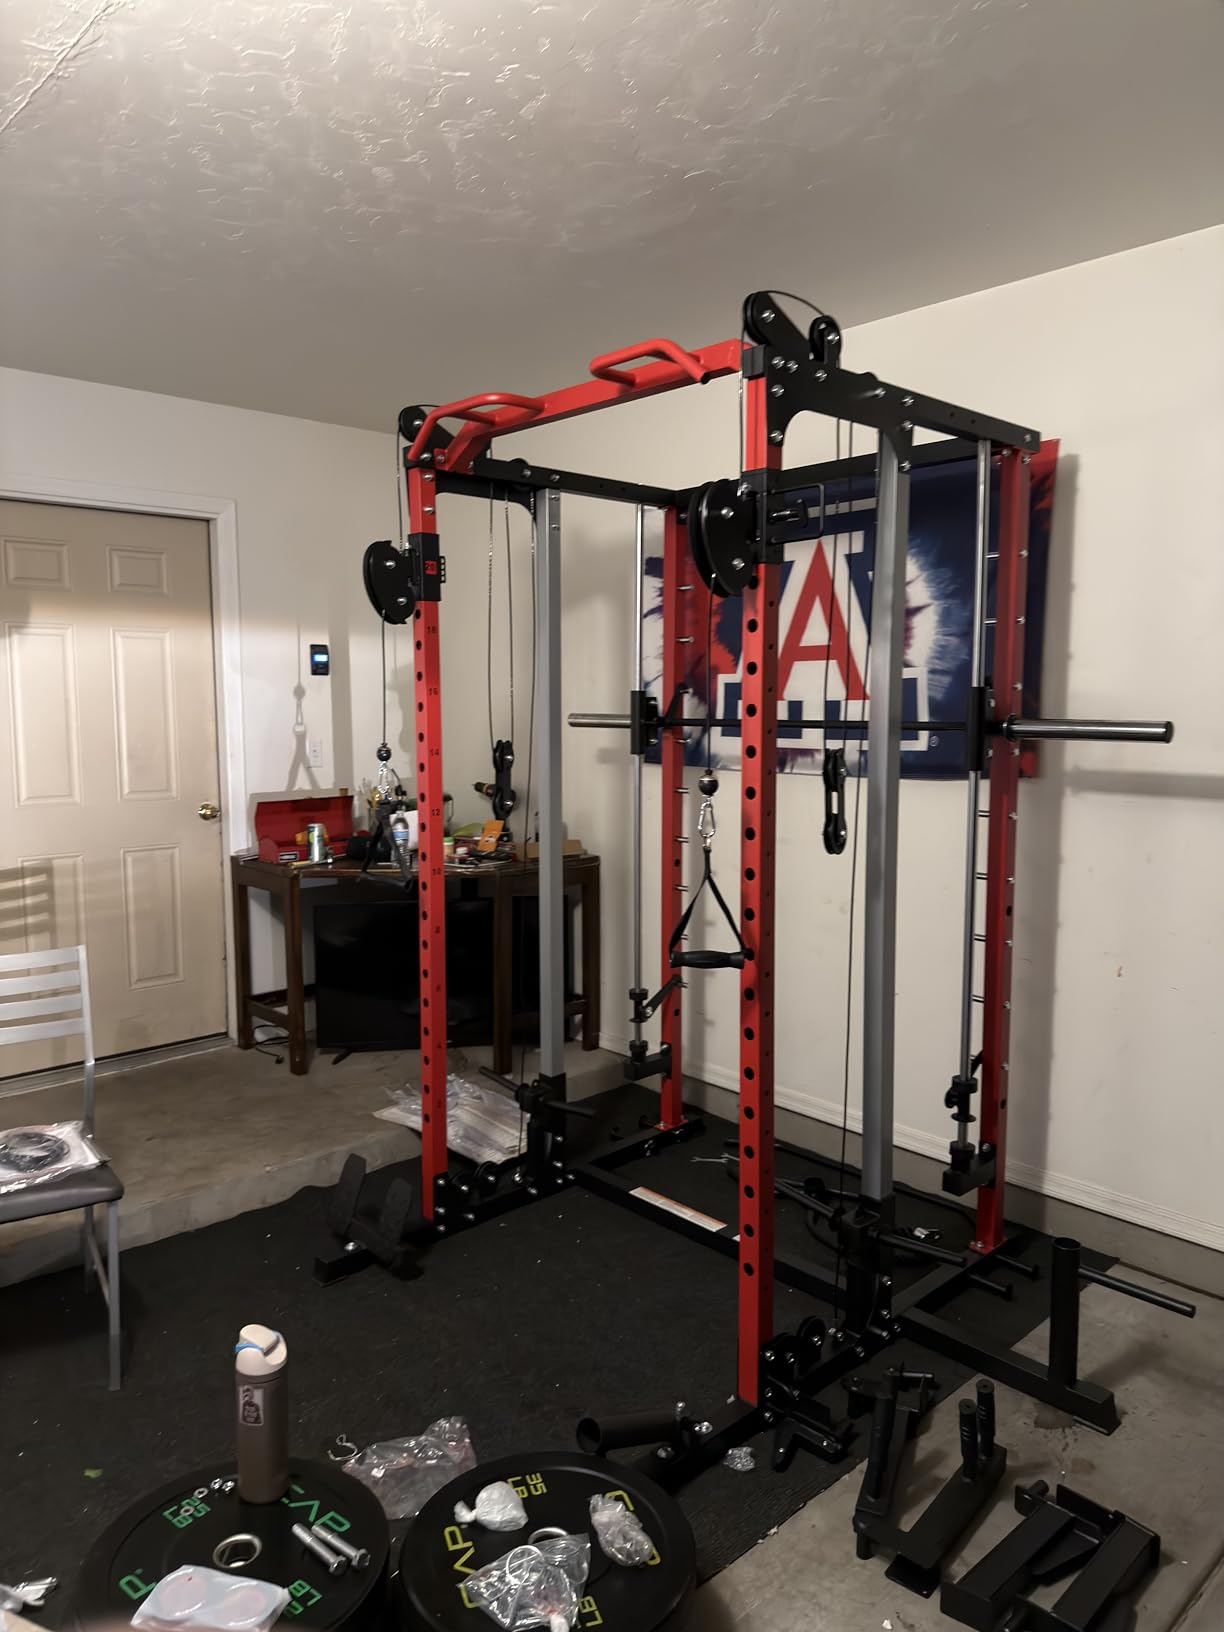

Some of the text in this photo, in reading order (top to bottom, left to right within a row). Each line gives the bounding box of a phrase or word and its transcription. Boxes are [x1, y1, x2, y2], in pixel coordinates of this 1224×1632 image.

[431, 808, 441, 816] 12
[525, 1472, 548, 1495] 35
[162, 1505, 193, 1529] LB
[288, 1580, 322, 1607] LB
[579, 1595, 604, 1627] LB
